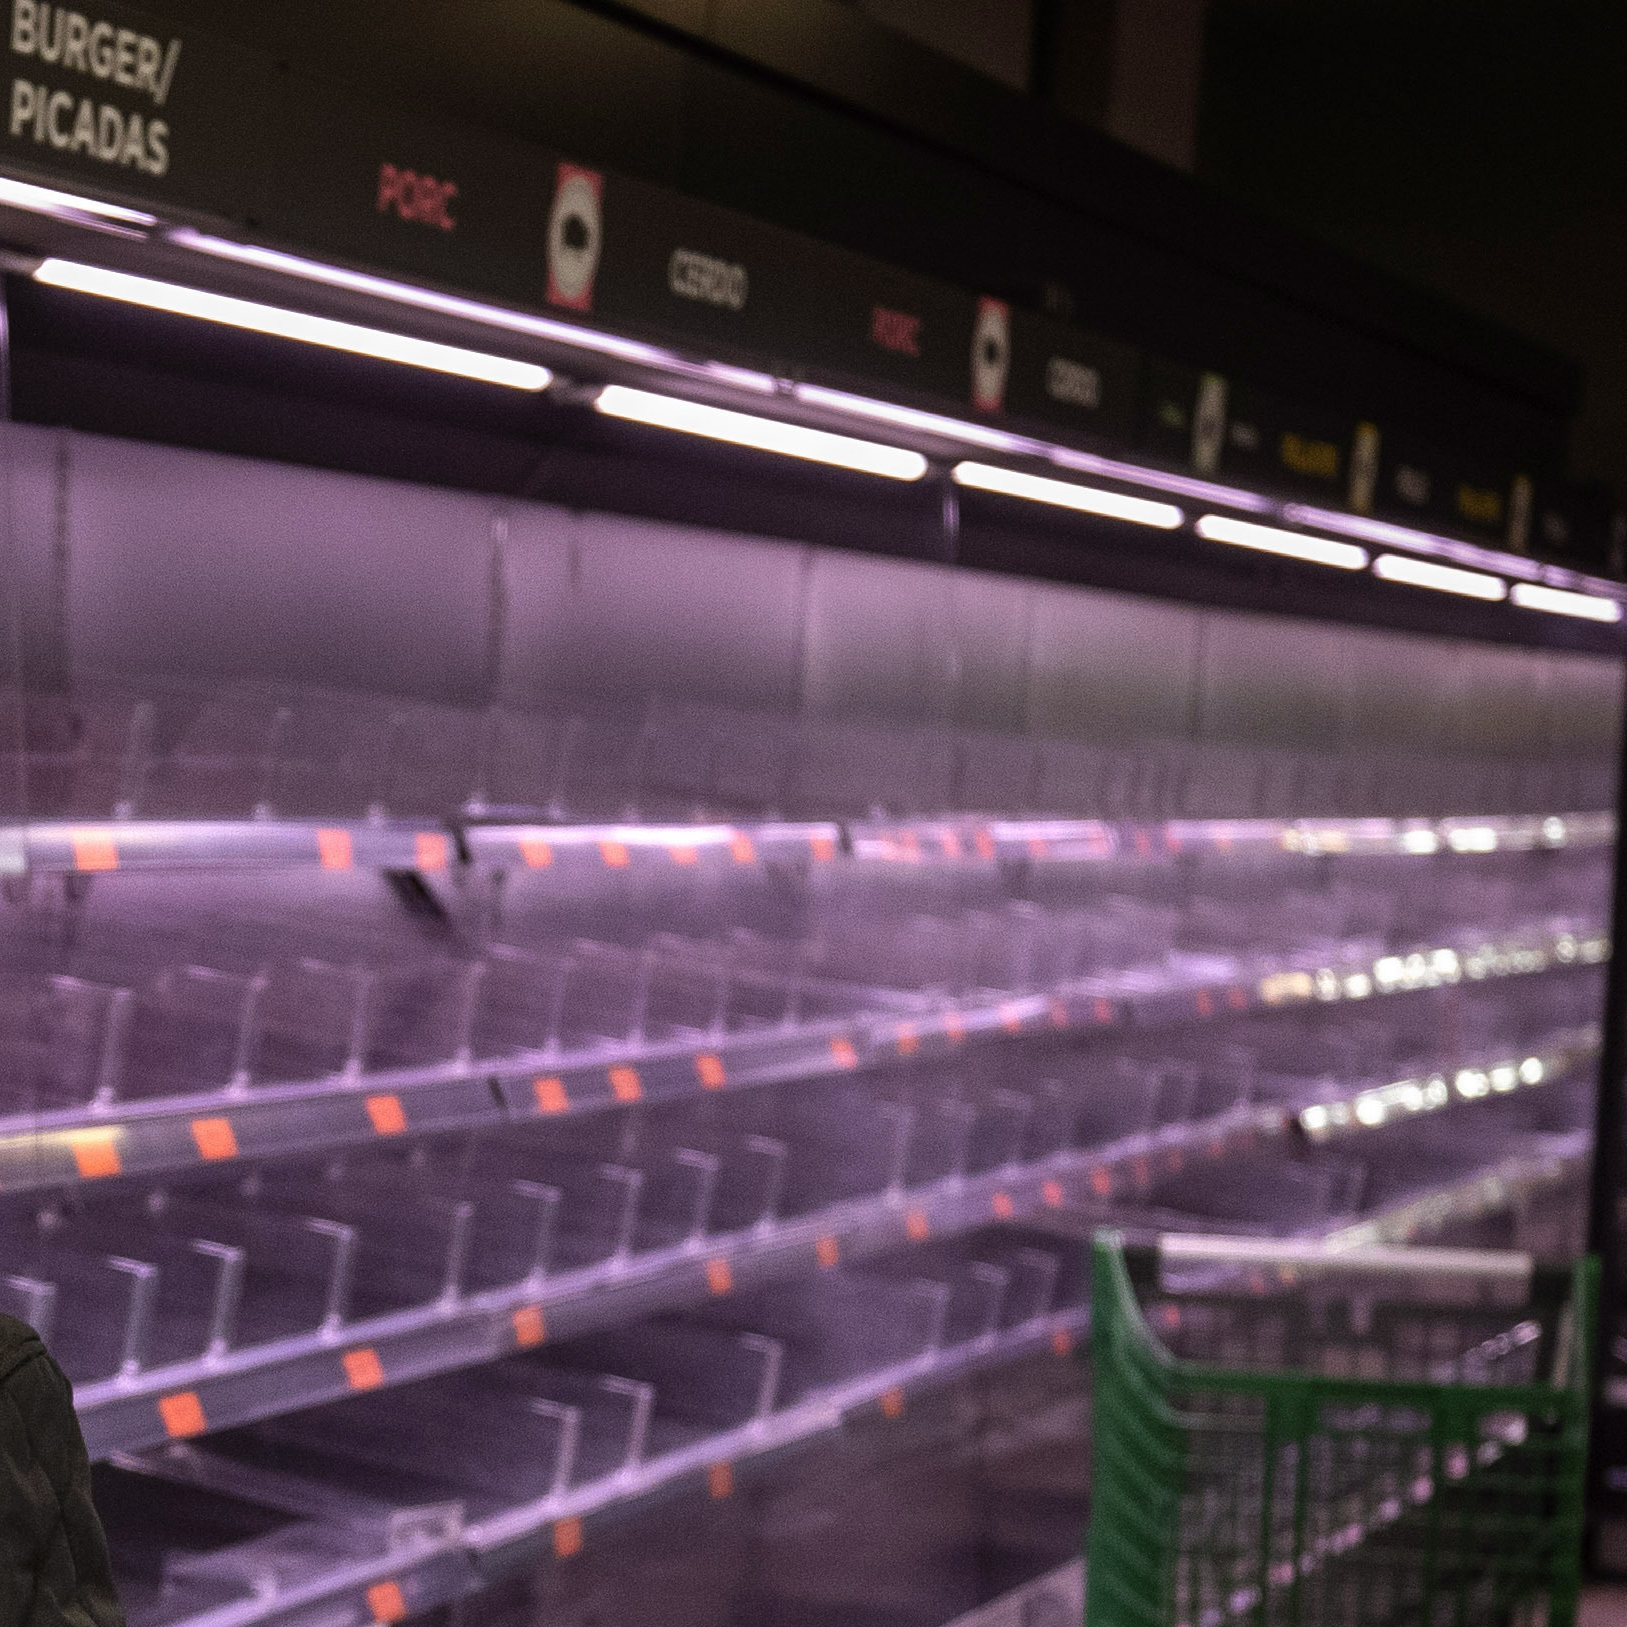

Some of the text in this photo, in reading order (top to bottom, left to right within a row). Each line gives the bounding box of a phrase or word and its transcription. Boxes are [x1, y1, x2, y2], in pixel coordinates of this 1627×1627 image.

[11, 0, 184, 104] BURGER/
[10, 78, 170, 176] PICADAS
[378, 163, 458, 230] PORC
